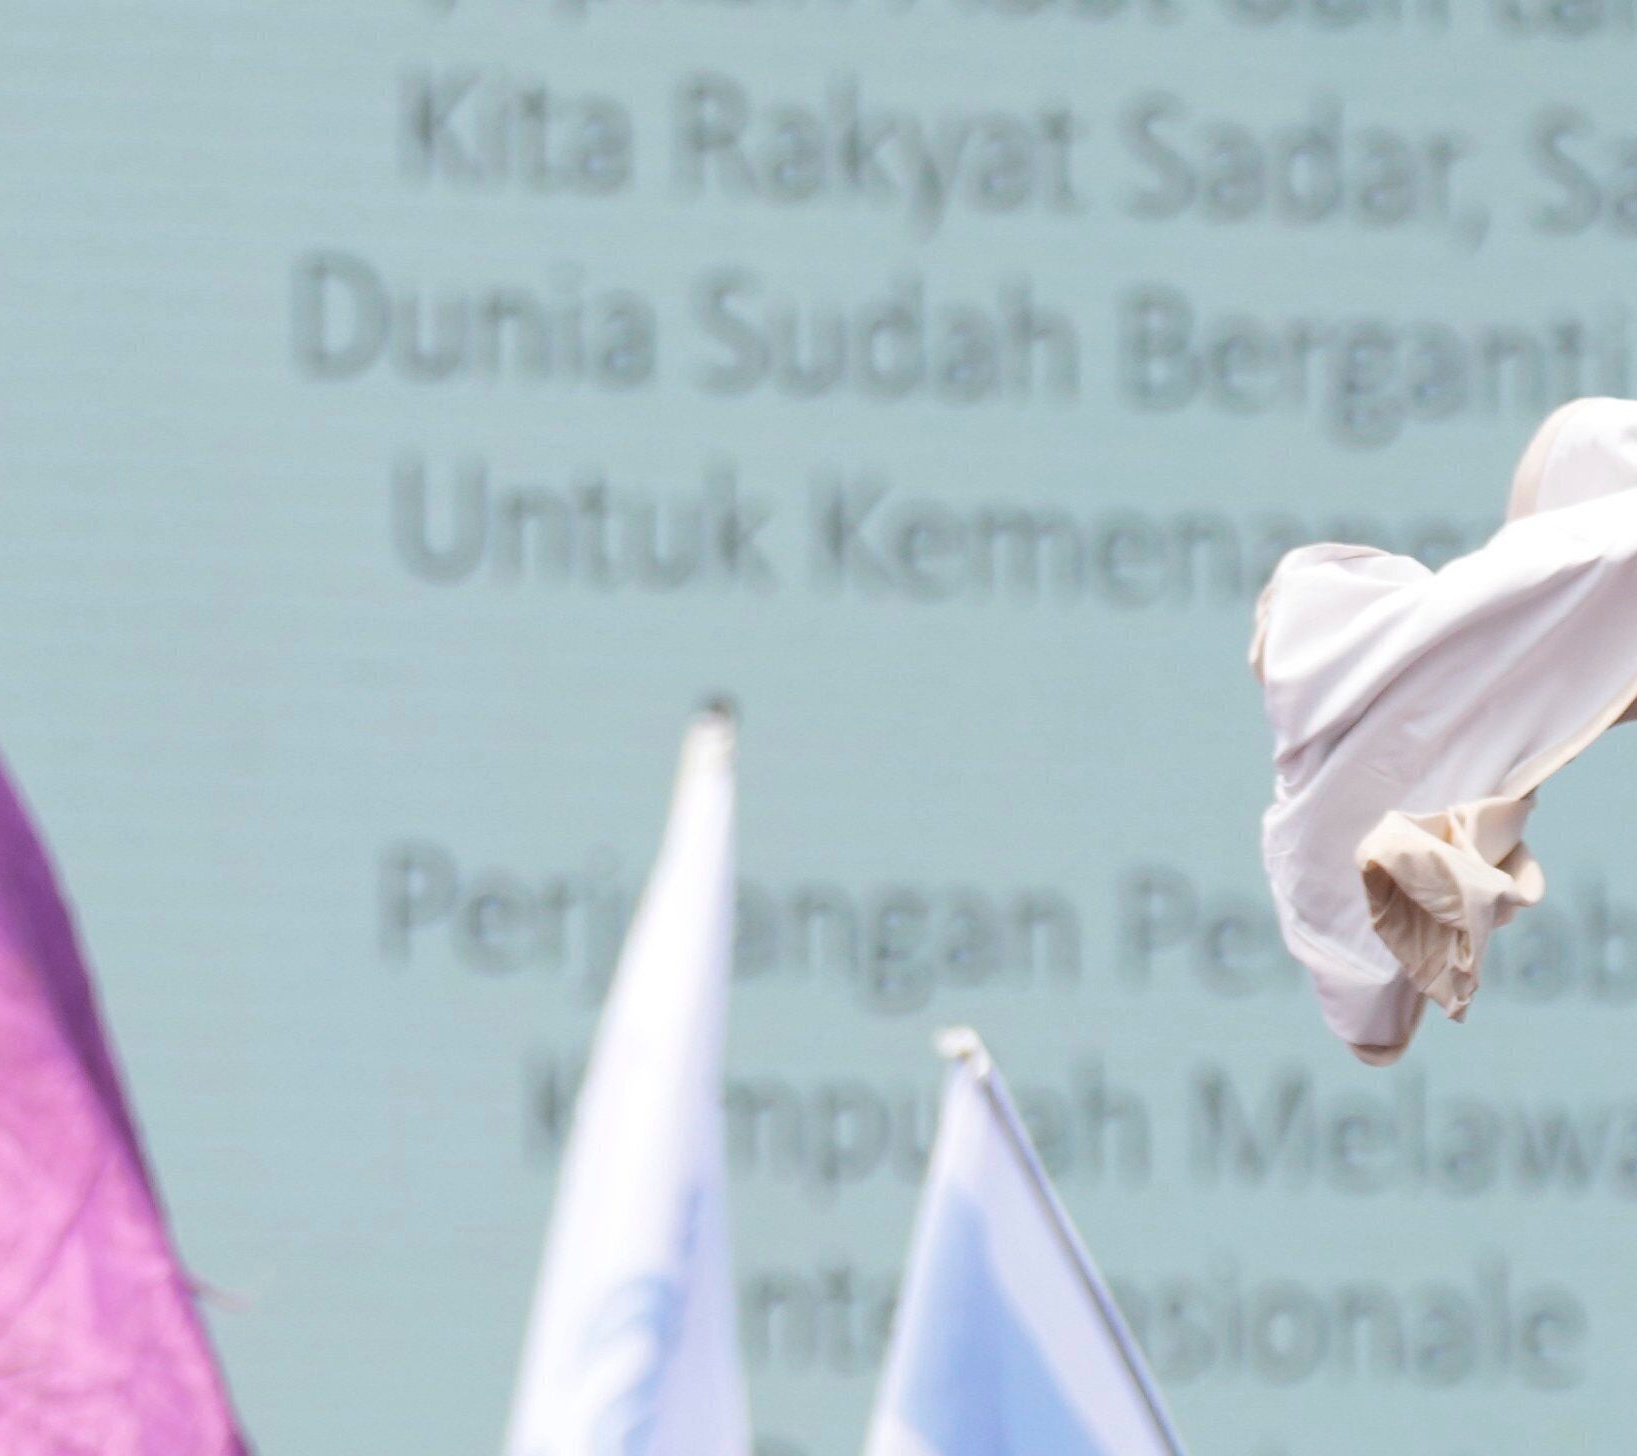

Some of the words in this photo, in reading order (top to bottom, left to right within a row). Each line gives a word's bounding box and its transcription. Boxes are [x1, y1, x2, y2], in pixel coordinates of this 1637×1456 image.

[395, 63, 633, 198] Kita
[670, 67, 1087, 243] Rakyat
[1119, 86, 1489, 255] Sadar,
[290, 249, 658, 392] Dunia
[690, 262, 1082, 408] Sudah
[1119, 282, 1628, 450] Berganti
[390, 447, 780, 594] Untuk
[375, 838, 1082, 1015] Perjangan
